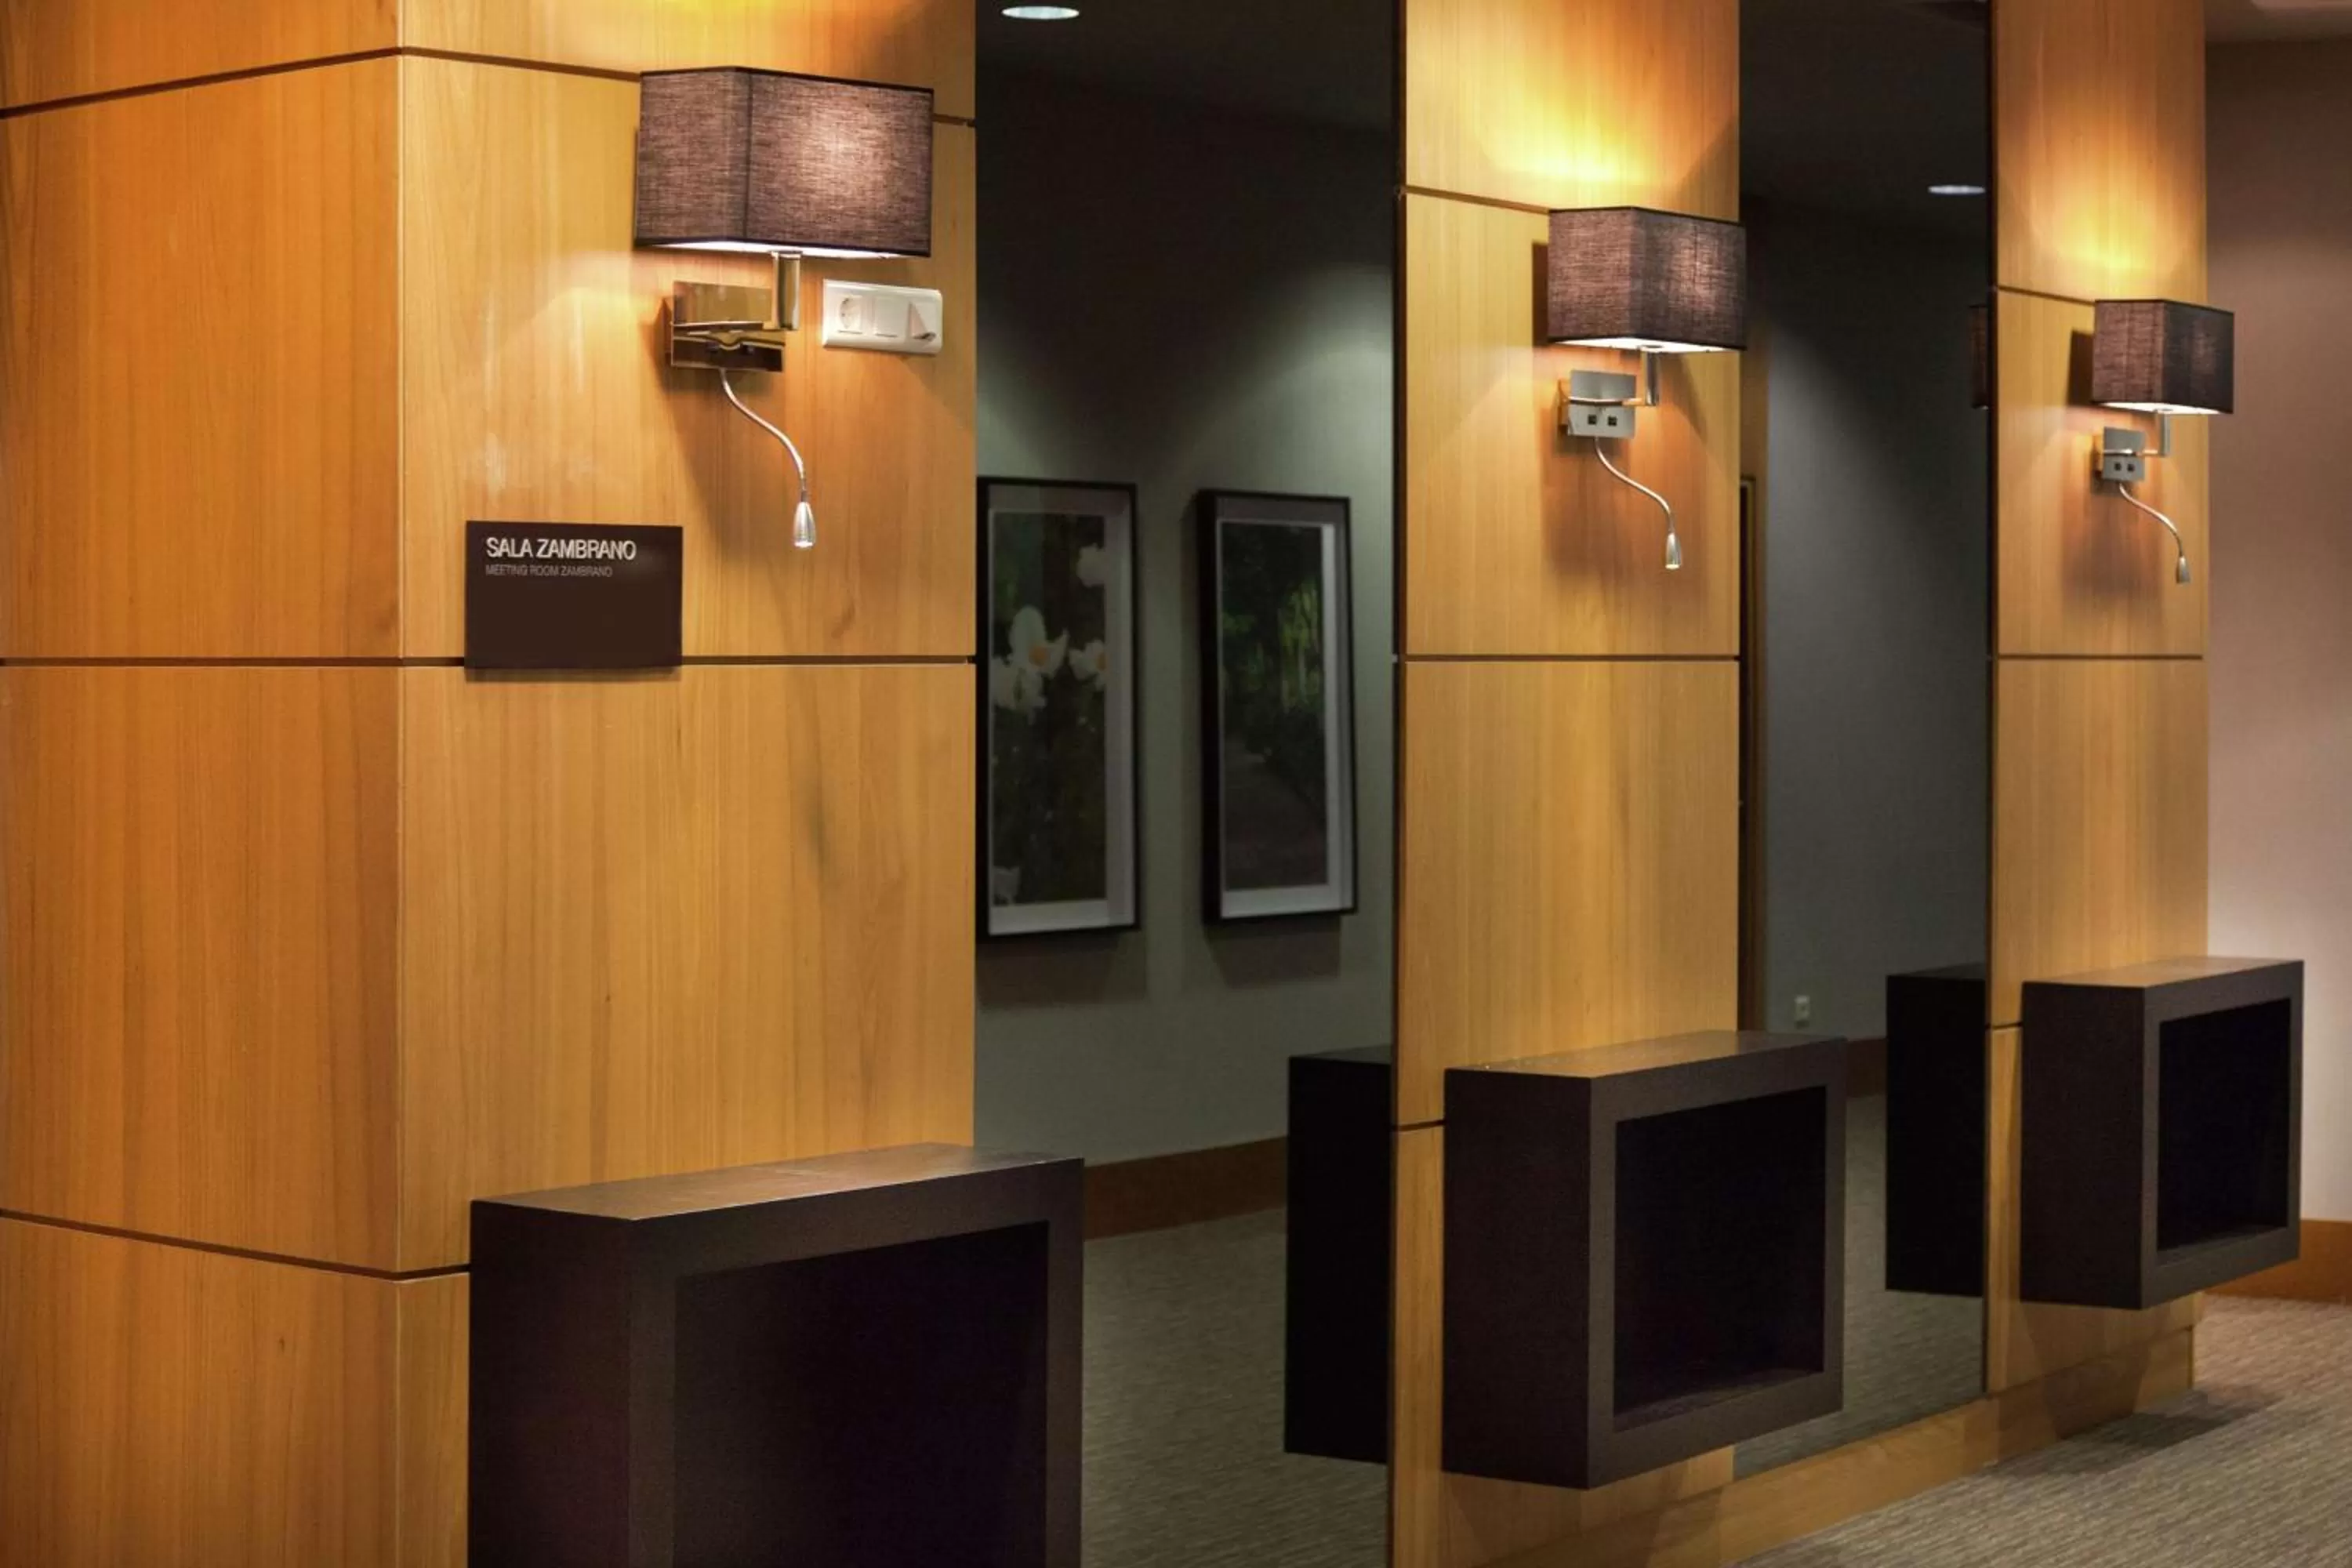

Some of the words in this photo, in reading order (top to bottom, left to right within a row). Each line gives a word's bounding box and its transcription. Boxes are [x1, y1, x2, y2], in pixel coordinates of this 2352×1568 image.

[486, 537, 533, 557] SALA
[536, 539, 637, 560] ZAMBRANO
[485, 564, 528, 576] MEETING
[530, 564, 559, 576] ROOM
[561, 564, 613, 577] ZAMBRANO
